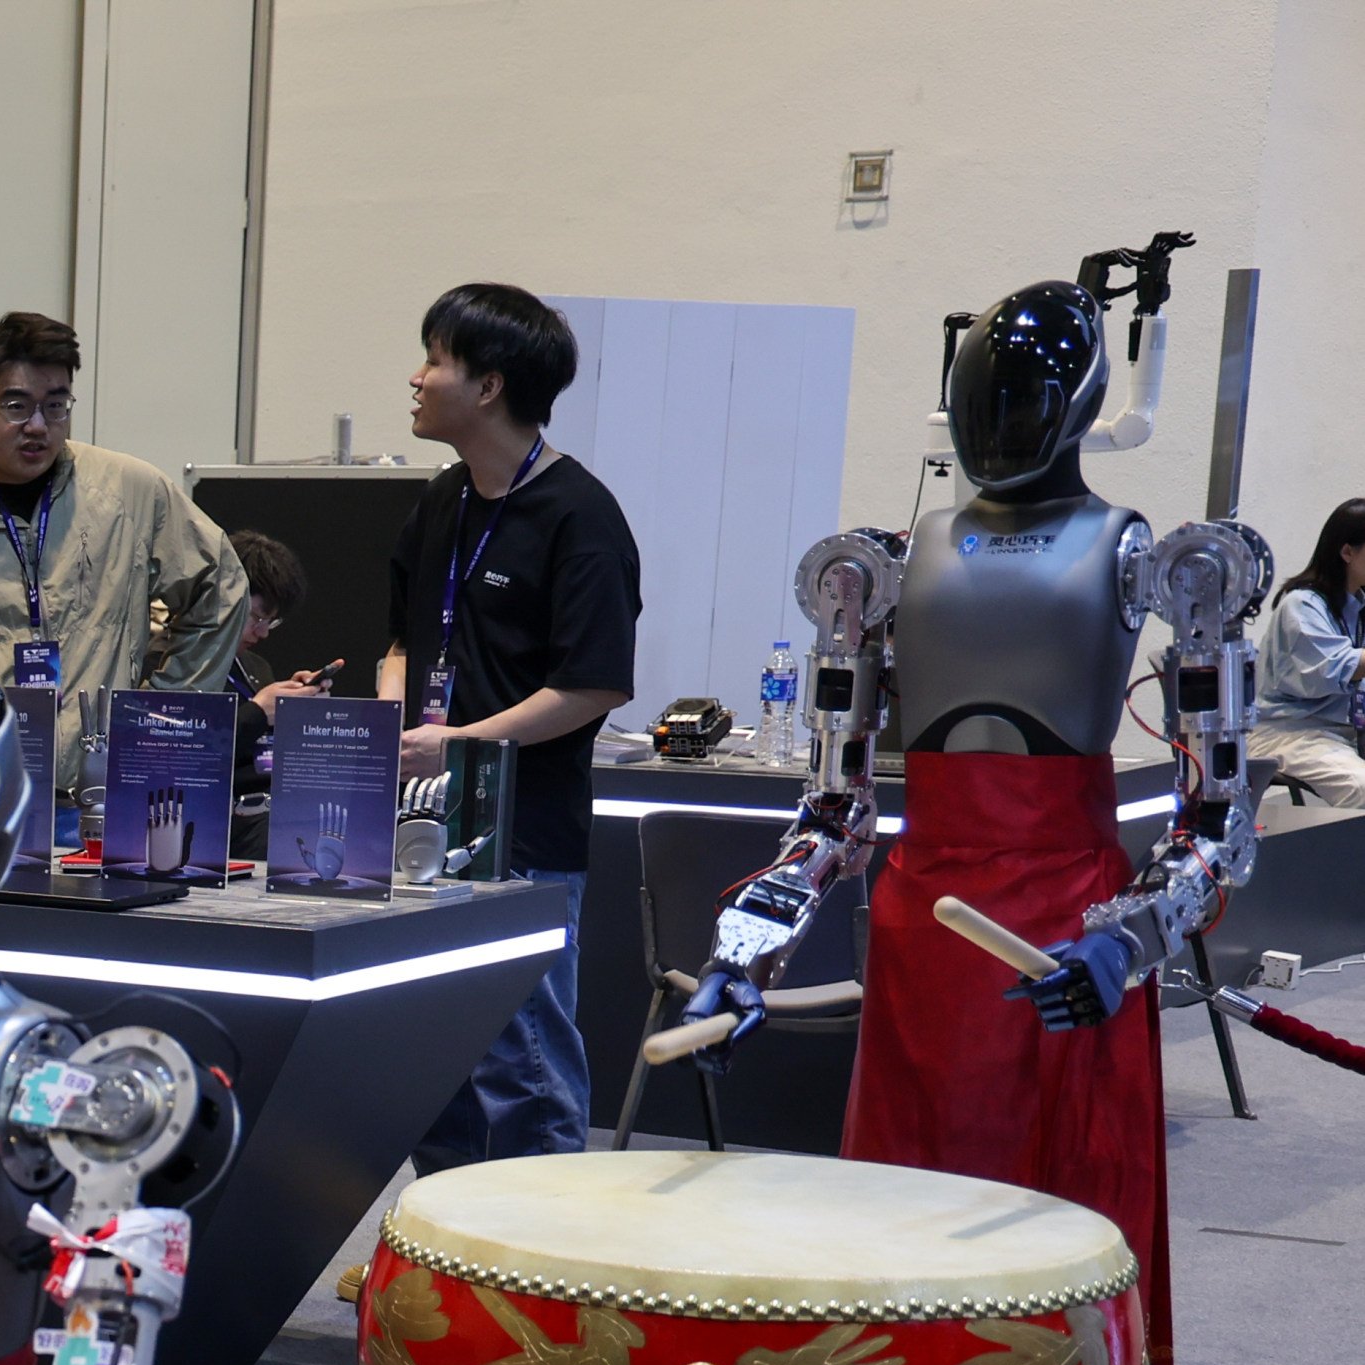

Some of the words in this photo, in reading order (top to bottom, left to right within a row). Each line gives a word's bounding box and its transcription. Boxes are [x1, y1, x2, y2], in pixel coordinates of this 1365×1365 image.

[138, 716, 167, 727] Linker
[195, 719, 207, 729] L6
[303, 725, 331, 736] Linker
[332, 726, 356, 737] Hand
